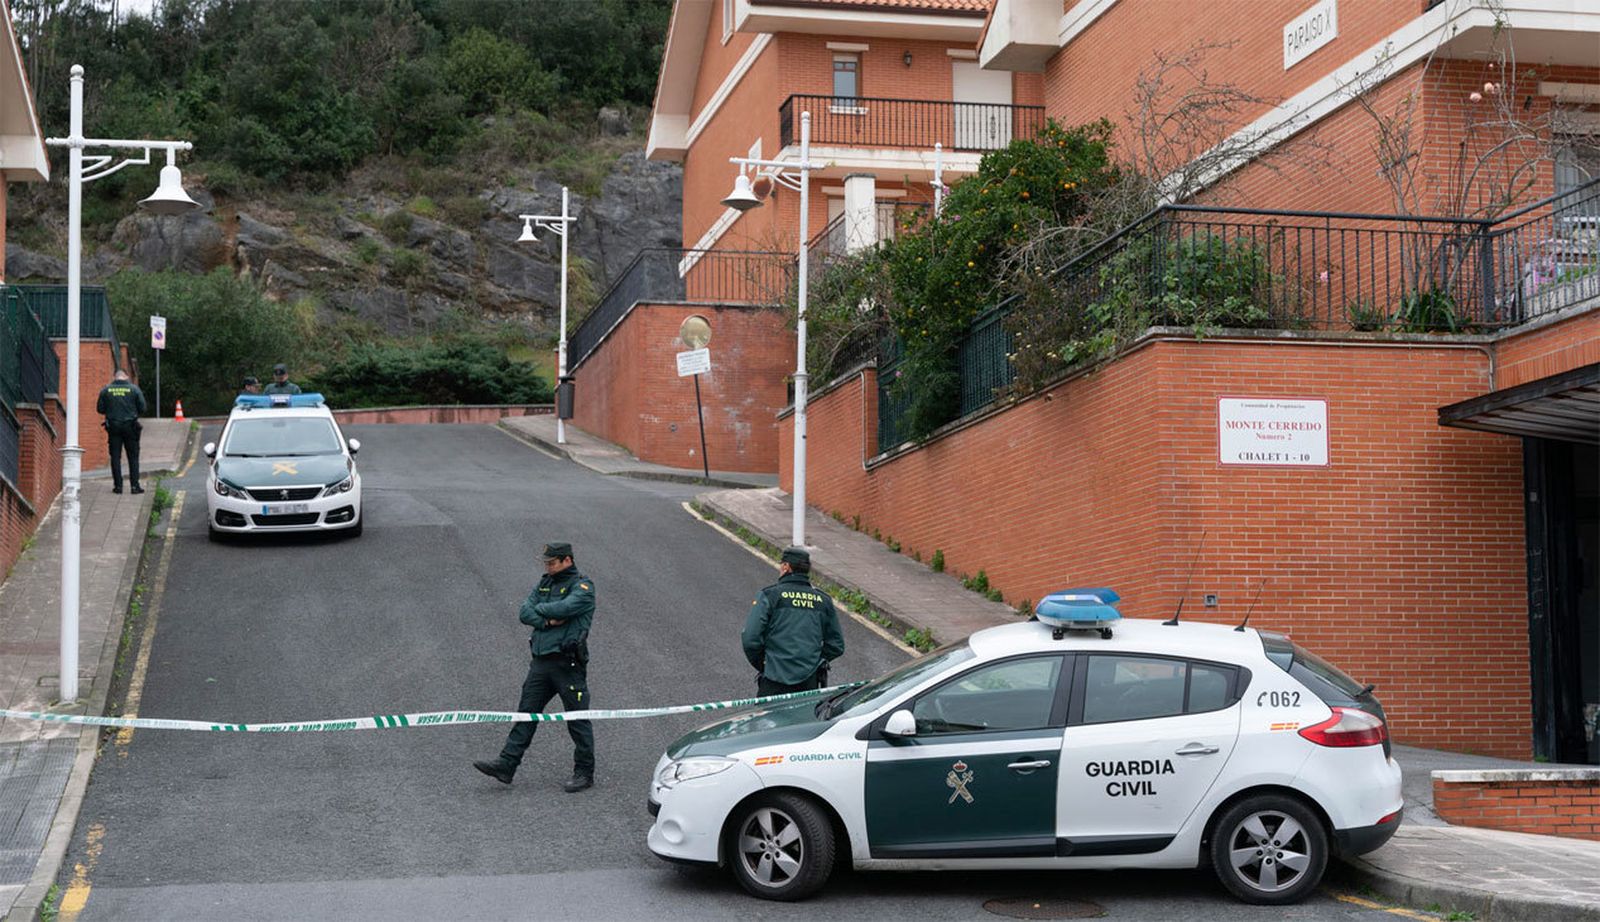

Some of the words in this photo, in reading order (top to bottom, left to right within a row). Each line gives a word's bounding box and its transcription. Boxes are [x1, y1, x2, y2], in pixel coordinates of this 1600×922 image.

[1287, 13, 1324, 57] PARAISO
[1225, 420, 1266, 430] MONTE
[1268, 421, 1322, 431] CERREDO
[1288, 432, 1292, 440] 2
[1238, 451, 1281, 461] CHALET
[1284, 453, 1289, 461] 1
[1299, 453, 1310, 461] 10
[781, 591, 823, 602] GUARDIA
[792, 599, 814, 608] CIVIL
[1270, 691, 1301, 707] 062
[789, 753, 834, 762] GUARDIA
[837, 752, 863, 760] CIVIL
[1085, 759, 1175, 777] GUARDIA
[1106, 781, 1157, 797] CIVIL
